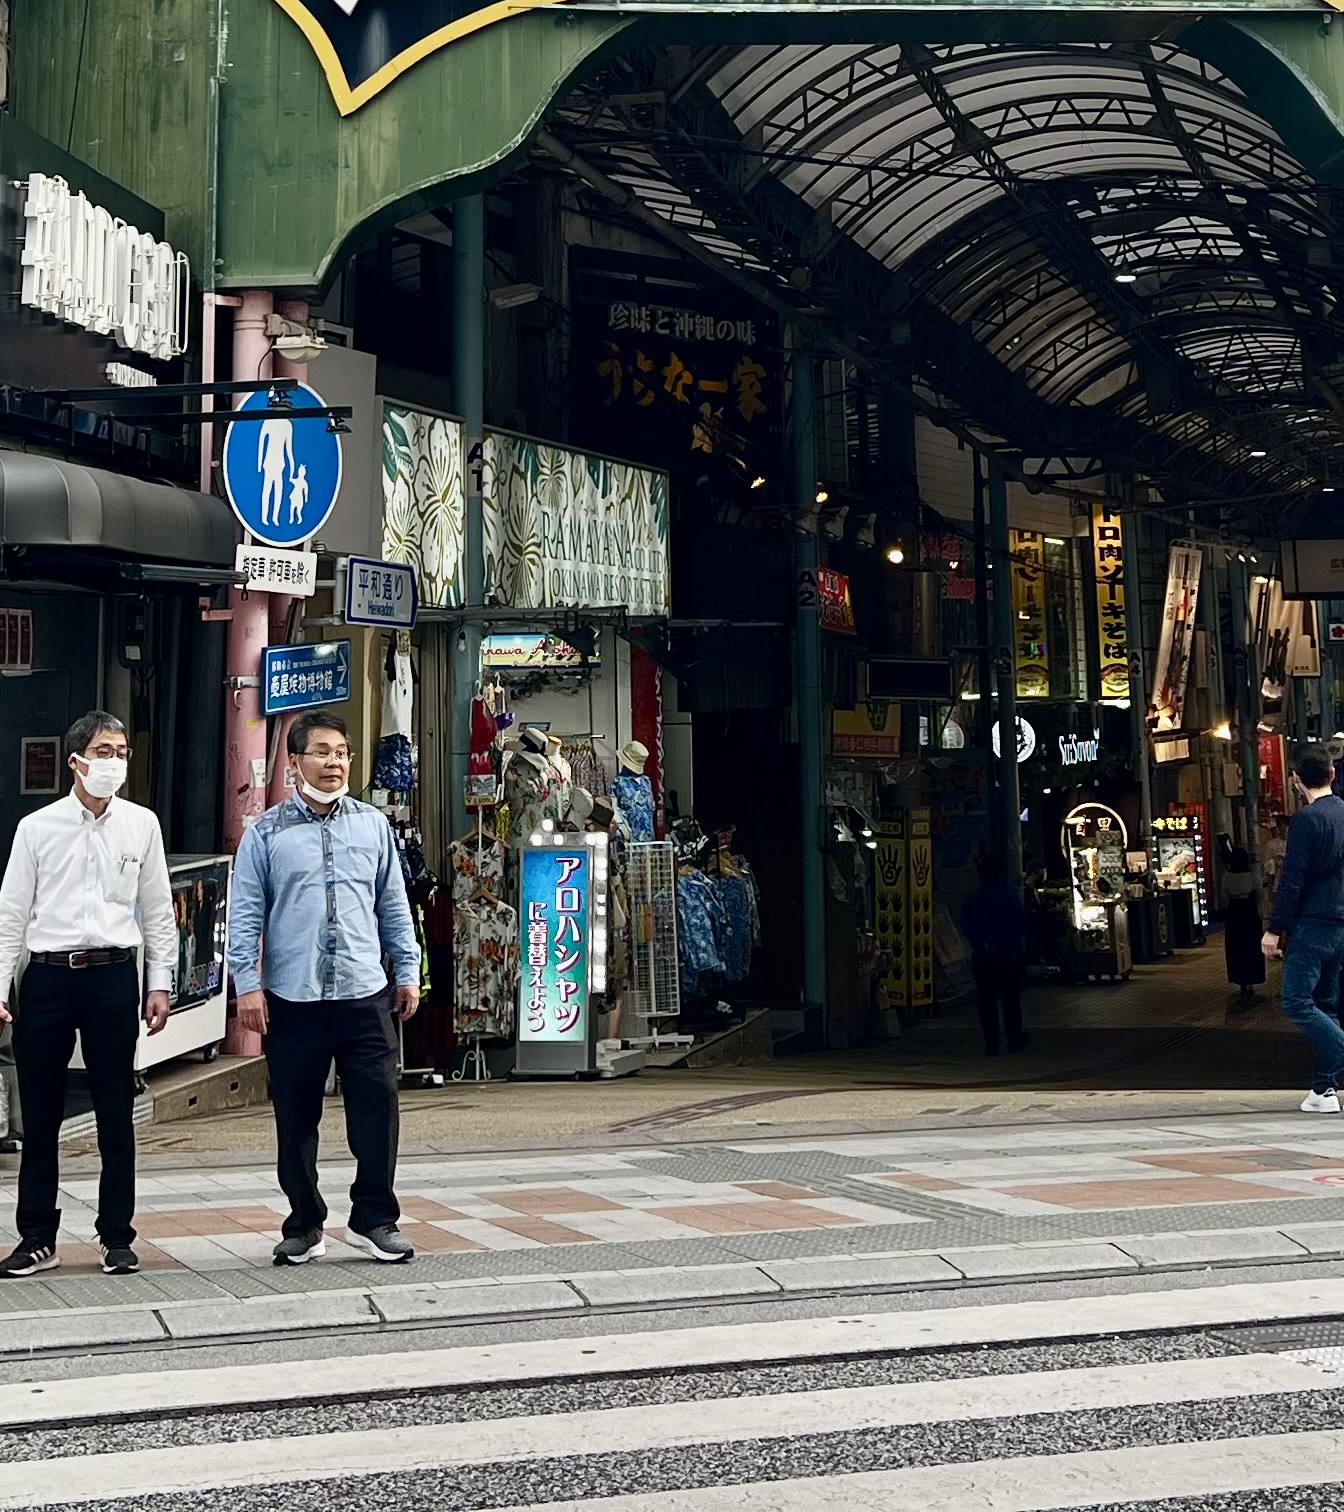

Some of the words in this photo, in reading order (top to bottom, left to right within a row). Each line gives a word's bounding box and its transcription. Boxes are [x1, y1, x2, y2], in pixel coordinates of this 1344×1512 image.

[607, 303, 757, 346] 珍味と沖縄の味
[541, 510, 634, 569] RAMAYANA
[358, 568, 405, 602] 平和通り
[551, 567, 603, 601] OKINAWA
[797, 570, 817, 587] A
[367, 600, 396, 618] Heiwadori
[798, 590, 816, 607] 2
[1058, 729, 1100, 766] SuiSavon
[552, 856, 583, 1035] アロハシャツ
[527, 901, 549, 1033] に着替えよう
